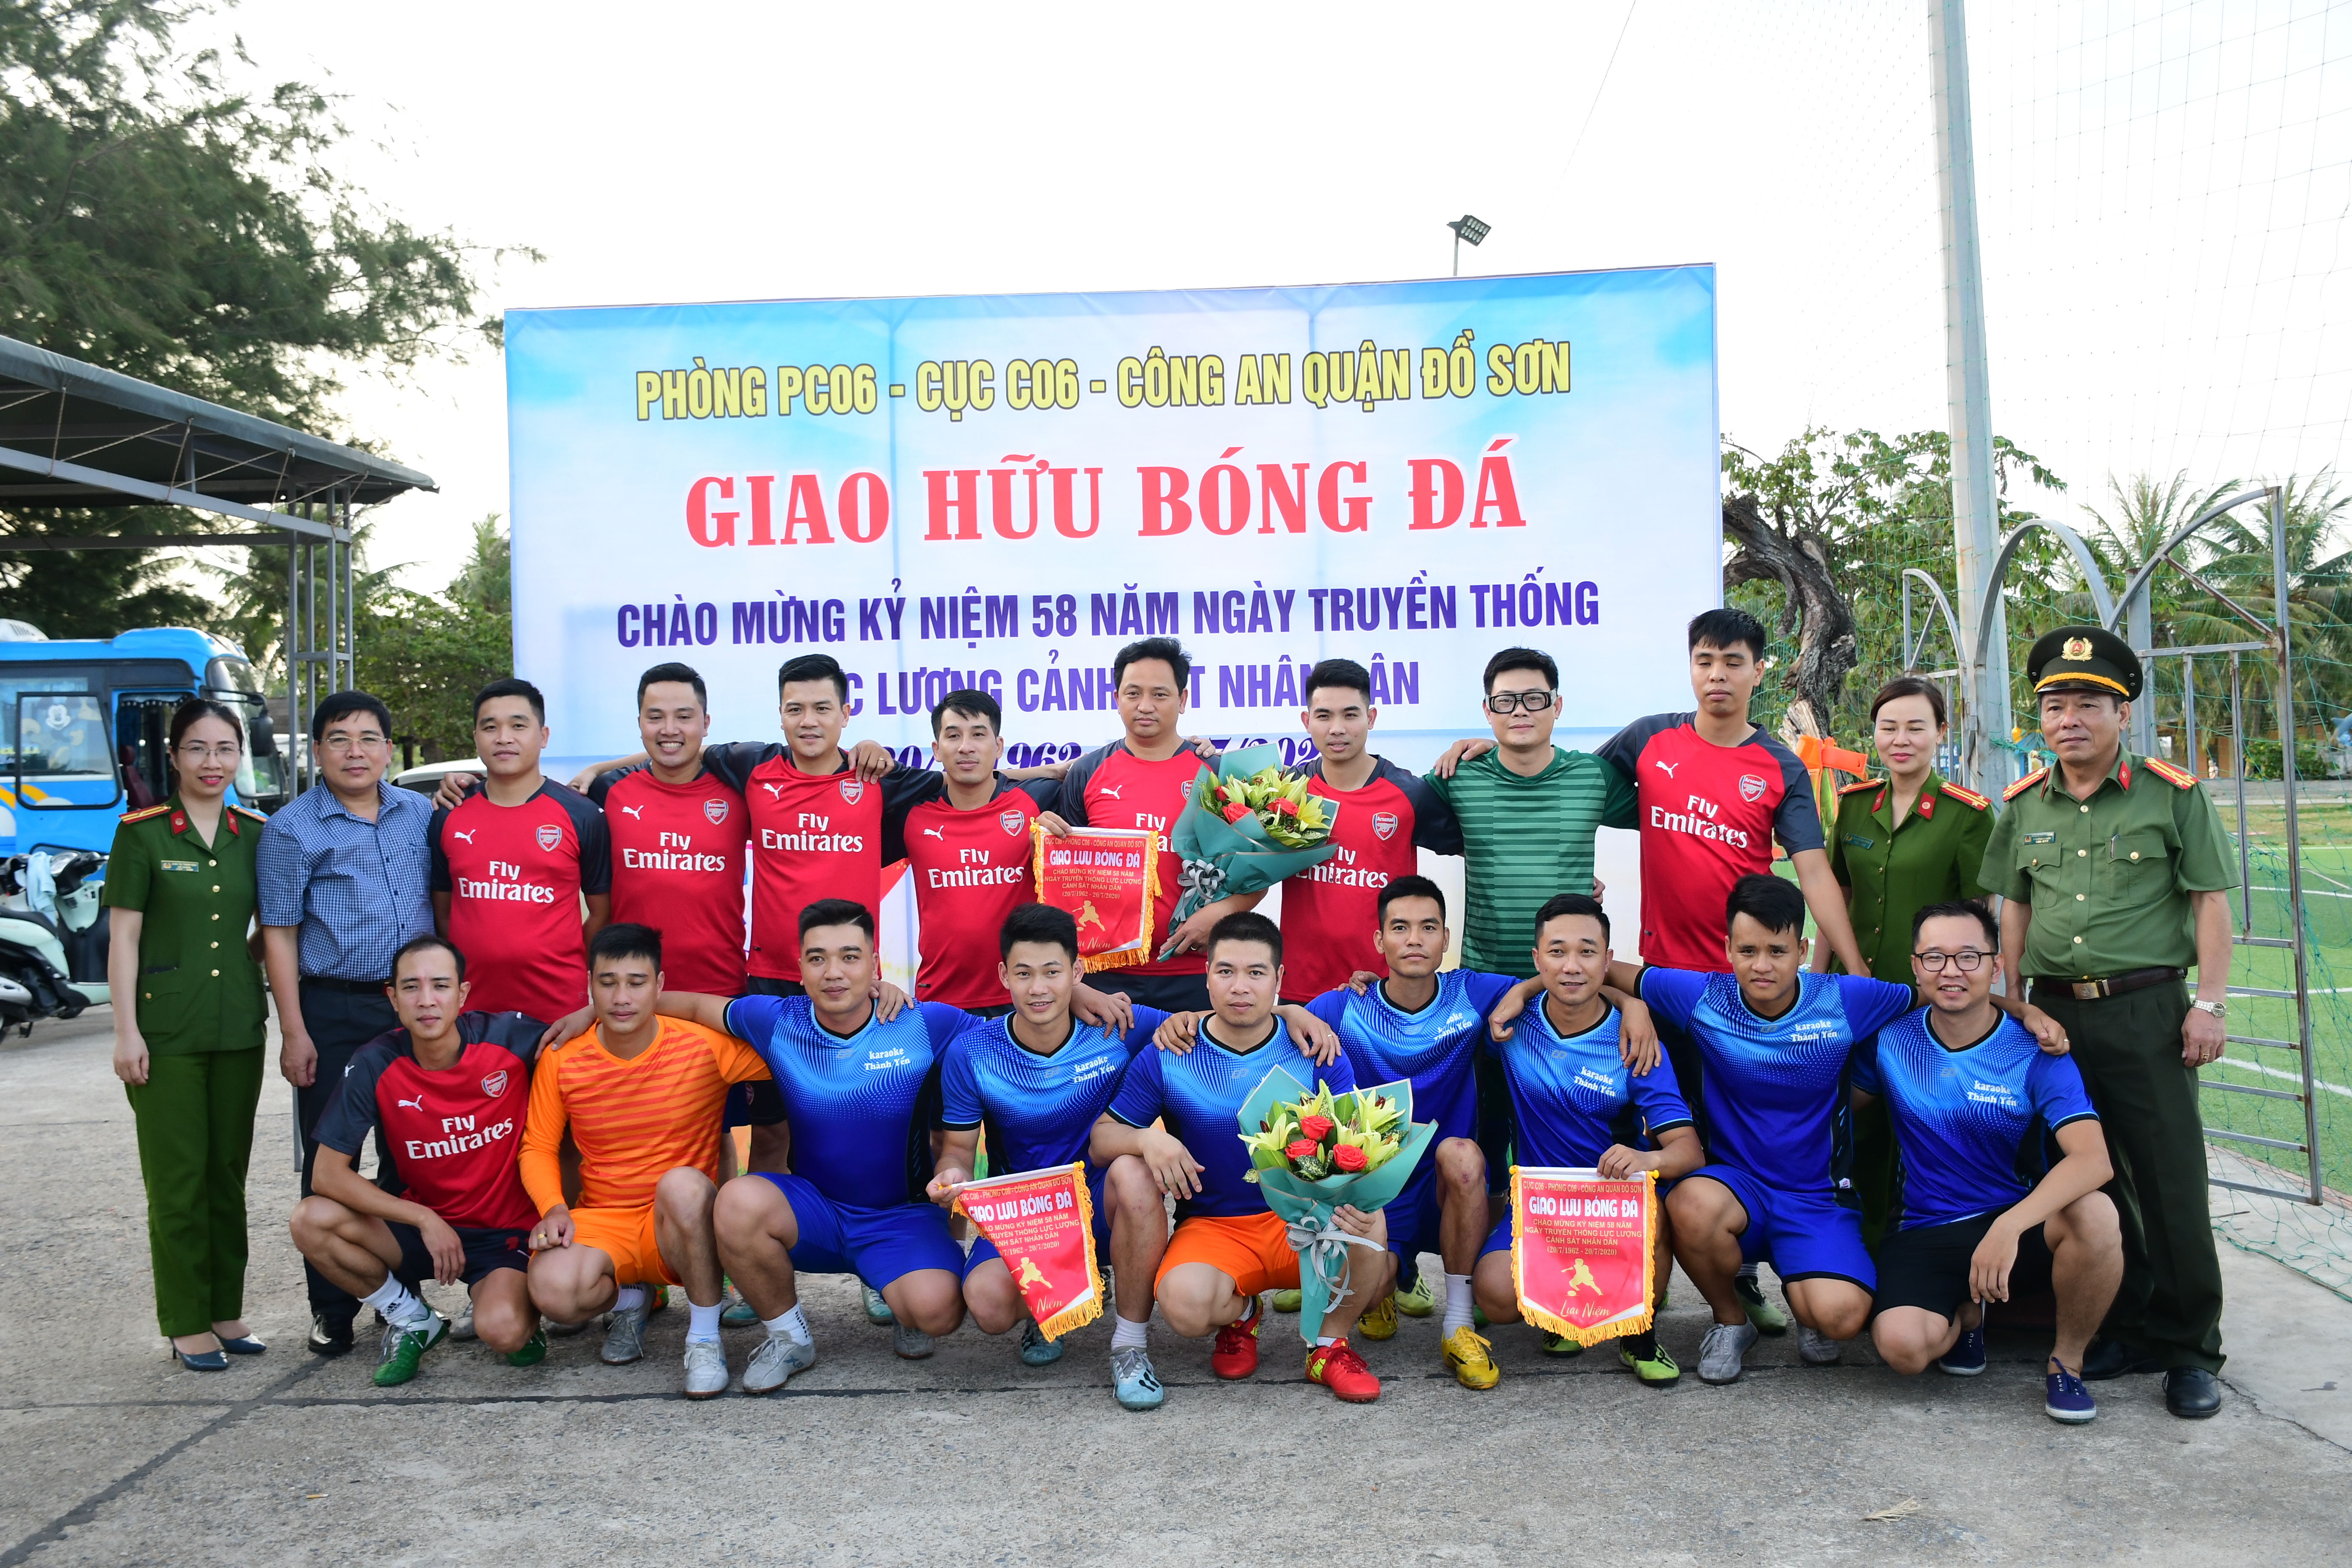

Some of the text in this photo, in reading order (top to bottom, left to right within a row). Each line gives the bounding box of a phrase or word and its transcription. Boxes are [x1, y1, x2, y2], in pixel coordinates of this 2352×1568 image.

[636, 357, 767, 421] PHÒNG
[778, 363, 877, 416] PC06
[916, 359, 995, 422] CỤC
[1006, 358, 1079, 410] C06
[1117, 346, 1225, 408] CÔNG
[1235, 354, 1291, 406] AN
[1302, 340, 1410, 412] QUẬN
[1421, 329, 1476, 399] ĐỒ
[1486, 339, 1571, 397] SƠN
[686, 438, 1526, 548] GIAO HỮU BÓNG ĐÁ
[617, 566, 1599, 648] CHÀO MỪNG KỶ NIỆM 58 NĂM NGÀY TRUYỀN THỐNG
[1016, 649, 1116, 712] CẢNH
[1745, 777, 1762, 786] Arsenal
[1687, 795, 1718, 819] Fly
[798, 813, 829, 832] Fly
[1136, 813, 1166, 831] Fly
[1651, 806, 1748, 848] Emirates
[660, 832, 691, 850] Fly
[762, 828, 863, 852] Emirates
[623, 849, 726, 871] Emirates
[960, 848, 989, 866] Fly
[1050, 849, 1140, 868] GIAO LƯU BÓNG ĐÁ
[489, 860, 520, 880] Fly
[928, 865, 1024, 888] Emirates
[458, 877, 555, 904] Emirates
[1795, 1020, 1831, 1031] karaoke
[869, 1048, 904, 1059] karaoke
[894, 1056, 910, 1066] Yến
[1075, 1056, 1108, 1073] karaoke
[1581, 1066, 1613, 1084] karaoke
[1974, 1080, 2011, 1094] karaoke
[441, 1115, 475, 1133] Fly
[405, 1117, 513, 1159] Emirates
[1523, 1181, 1534, 1191] CỤC
[1631, 1185, 1642, 1193] SƠN
[968, 1187, 1073, 1222] GIAO LƯU BÓNG ĐÁ
[1529, 1195, 1638, 1217] GIAO LƯU BÓNG ĐÁ
[1054, 1213, 1069, 1221] NĂM
[1029, 1241, 1059, 1252] 20/7/2020)
[1582, 1301, 1610, 1318] Niệm
